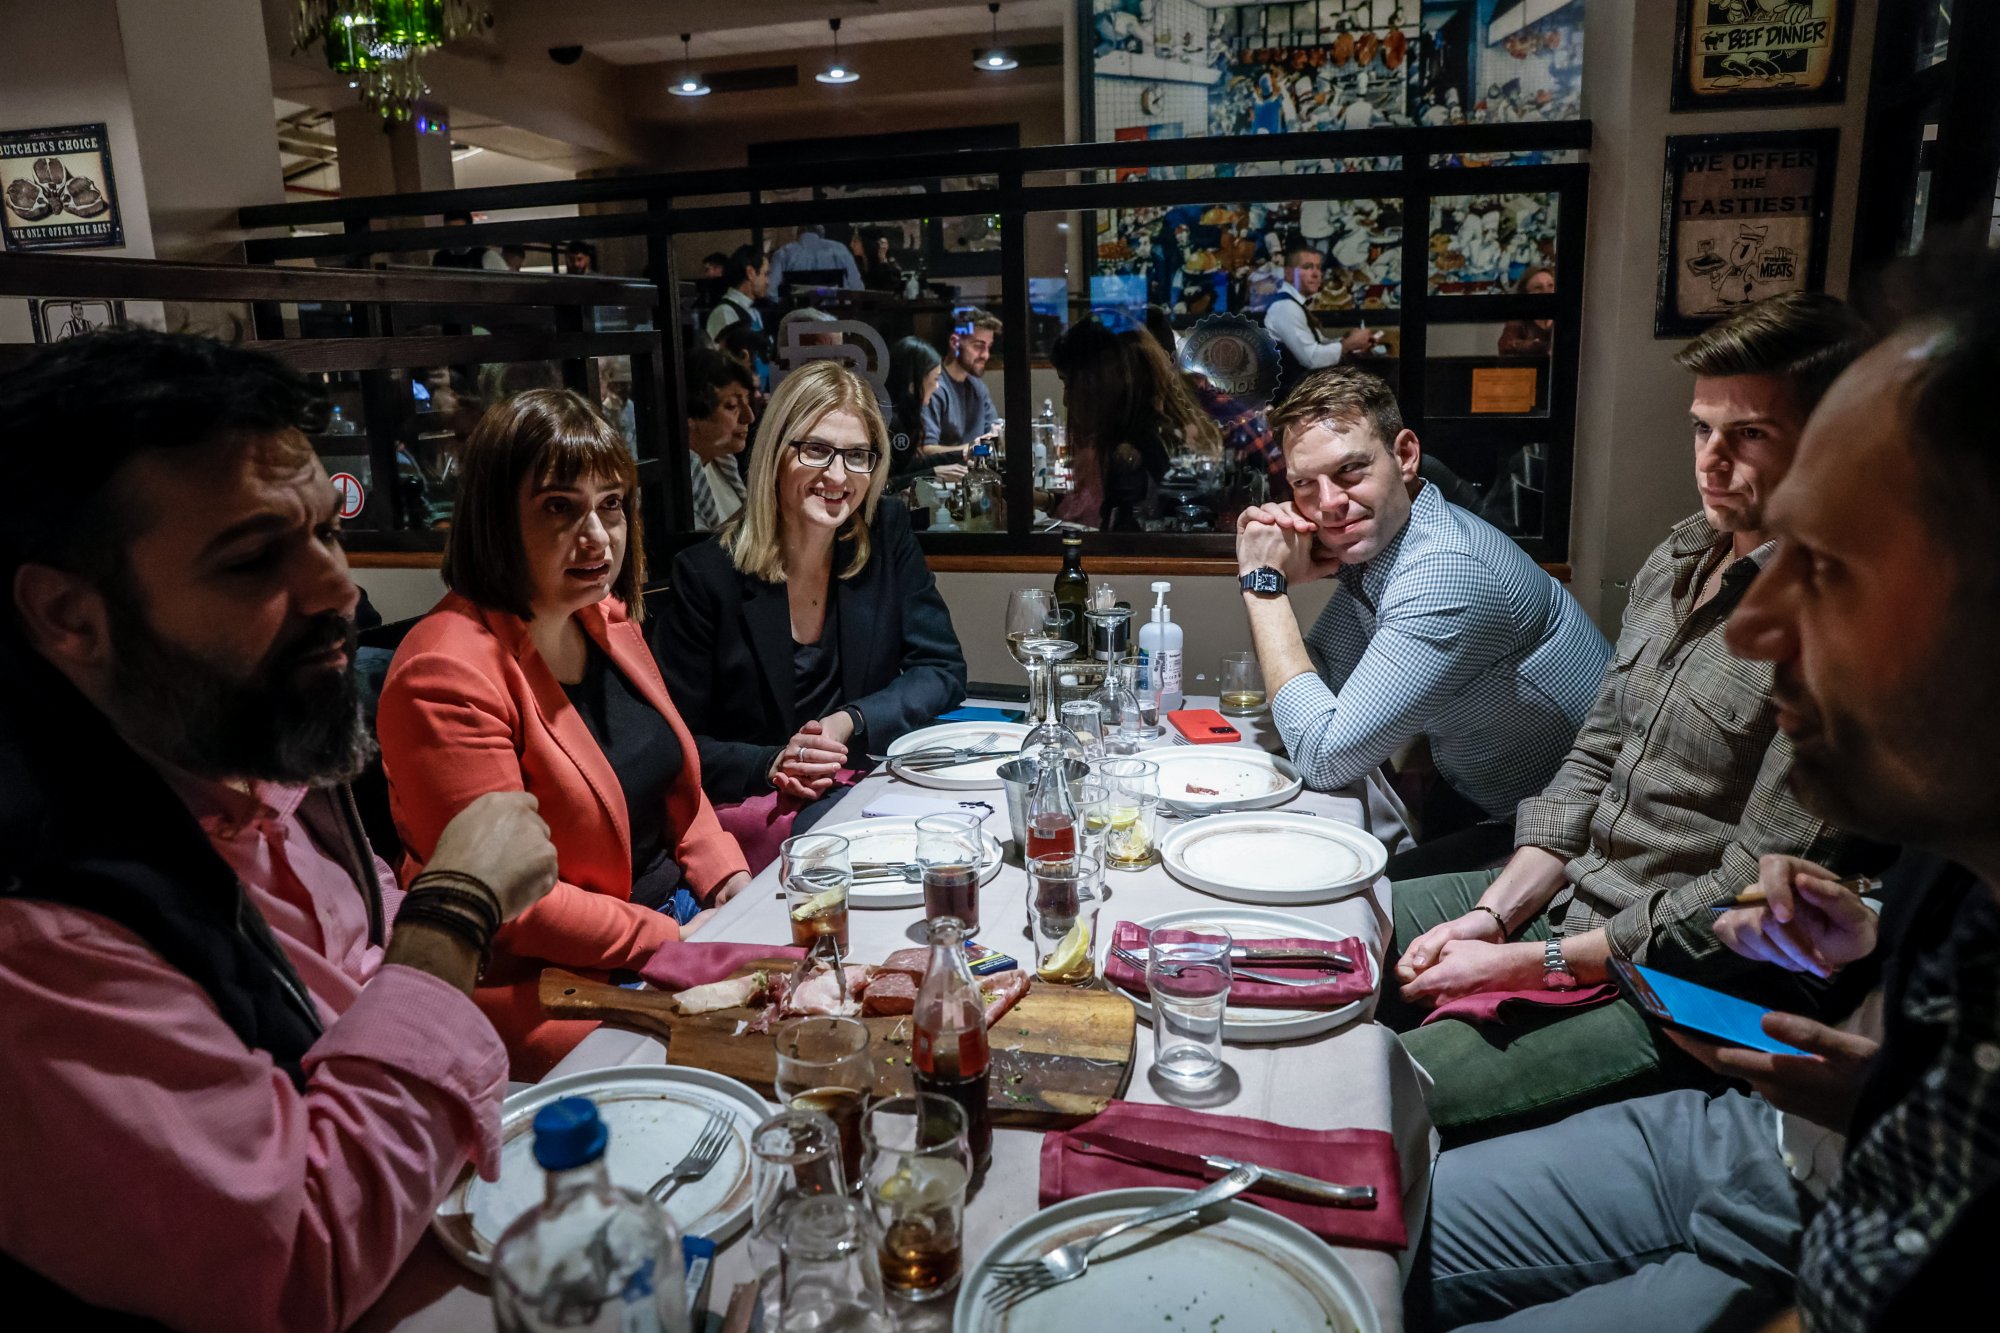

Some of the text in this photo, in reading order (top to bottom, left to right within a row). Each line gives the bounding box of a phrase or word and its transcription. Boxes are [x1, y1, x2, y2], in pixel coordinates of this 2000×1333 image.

[1727, 21, 1827, 50] BEEF DINNER
[58, 137, 98, 151] CHOICE
[1686, 151, 1816, 173] WE OFFER
[1731, 177, 1767, 189] THE
[1681, 196, 1815, 215] TASTIEST
[12, 223, 111, 239] WE ONLY OFFER THE BEST
[1759, 263, 1794, 279] MEATS
